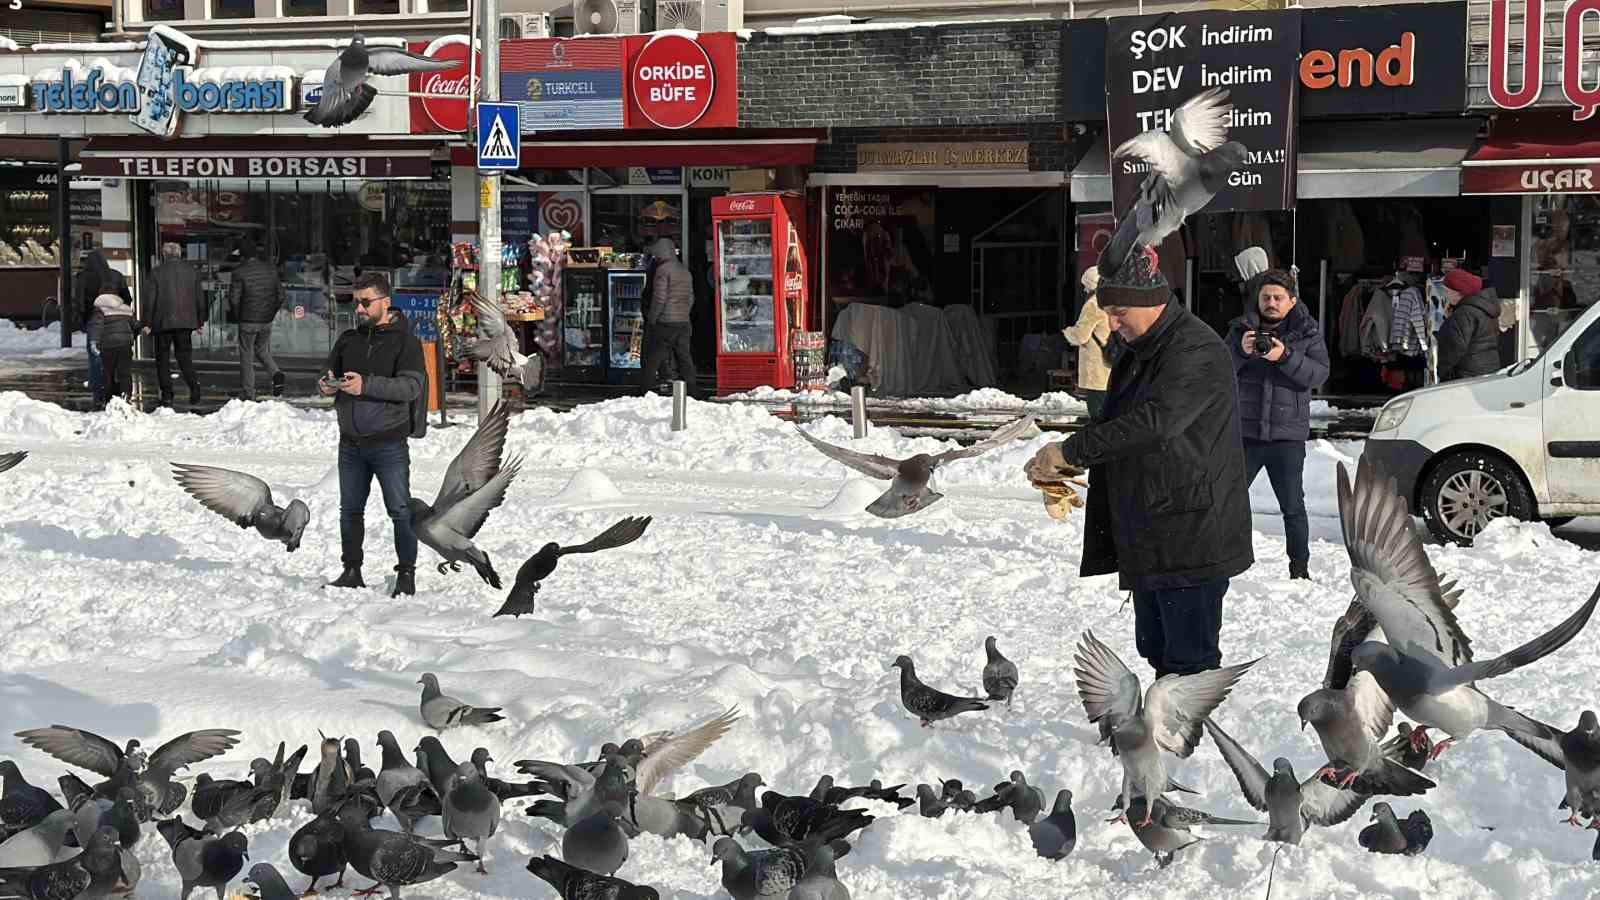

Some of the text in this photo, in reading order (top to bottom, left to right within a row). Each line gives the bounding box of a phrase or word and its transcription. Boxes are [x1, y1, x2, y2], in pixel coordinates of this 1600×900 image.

[1130, 24, 1273, 60] ŞOK İndirim
[1297, 31, 1416, 89] end
[639, 61, 706, 81] ORKİDE
[1132, 64, 1272, 94] DEV İndirim
[32, 66, 137, 110] Telefon
[545, 82, 597, 96] TURKCELL
[650, 83, 697, 102] BÜFE
[1222, 108, 1272, 128] dirim
[119, 157, 366, 176] TELEFON BORSASI
[1244, 149, 1285, 165] MA!!
[36, 173, 59, 185] 444
[692, 167, 731, 181] KONT
[1227, 171, 1262, 187] Gün
[1520, 168, 1595, 191] UÇAR
